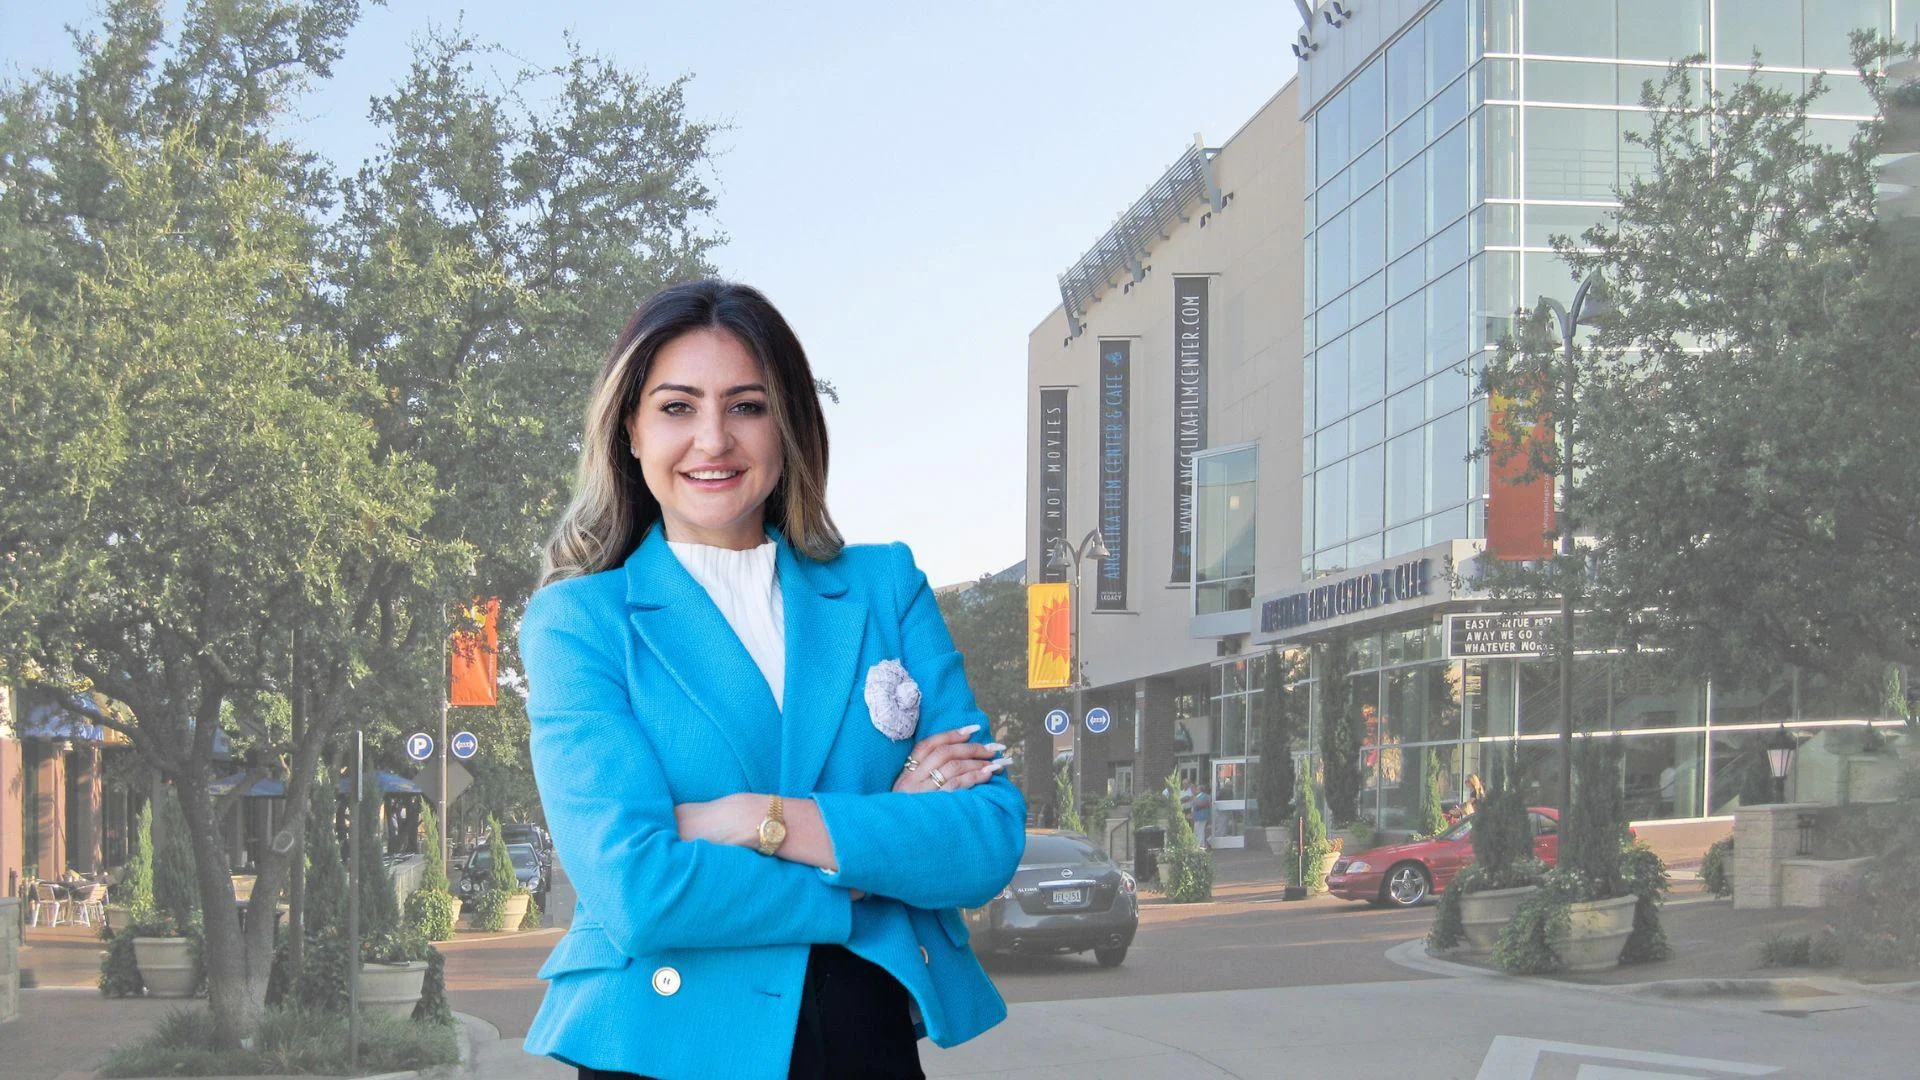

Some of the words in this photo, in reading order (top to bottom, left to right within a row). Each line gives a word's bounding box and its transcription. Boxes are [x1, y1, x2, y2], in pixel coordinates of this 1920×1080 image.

[1105, 374, 1123, 406] CAFE
[1180, 294, 1201, 534] WWWANGELIKAFILMCENTER.COM
[1046, 406, 1061, 473] MOVIES
[1104, 424, 1122, 474] CENTER
[1046, 486, 1061, 519] NOT
[1104, 479, 1122, 510] FILM
[1103, 514, 1121, 580] ANGELIKA
[1333, 572, 1374, 616] CENTER
[1393, 557, 1424, 602] CAFE
[1465, 618, 1490, 631] EASY
[1466, 630, 1496, 642] AWAY
[1501, 630, 1514, 641] WE
[1518, 630, 1532, 640] GO
[1464, 641, 1516, 653] WHATEVER
[1051, 714, 1063, 731] P
[413, 738, 427, 755] P
